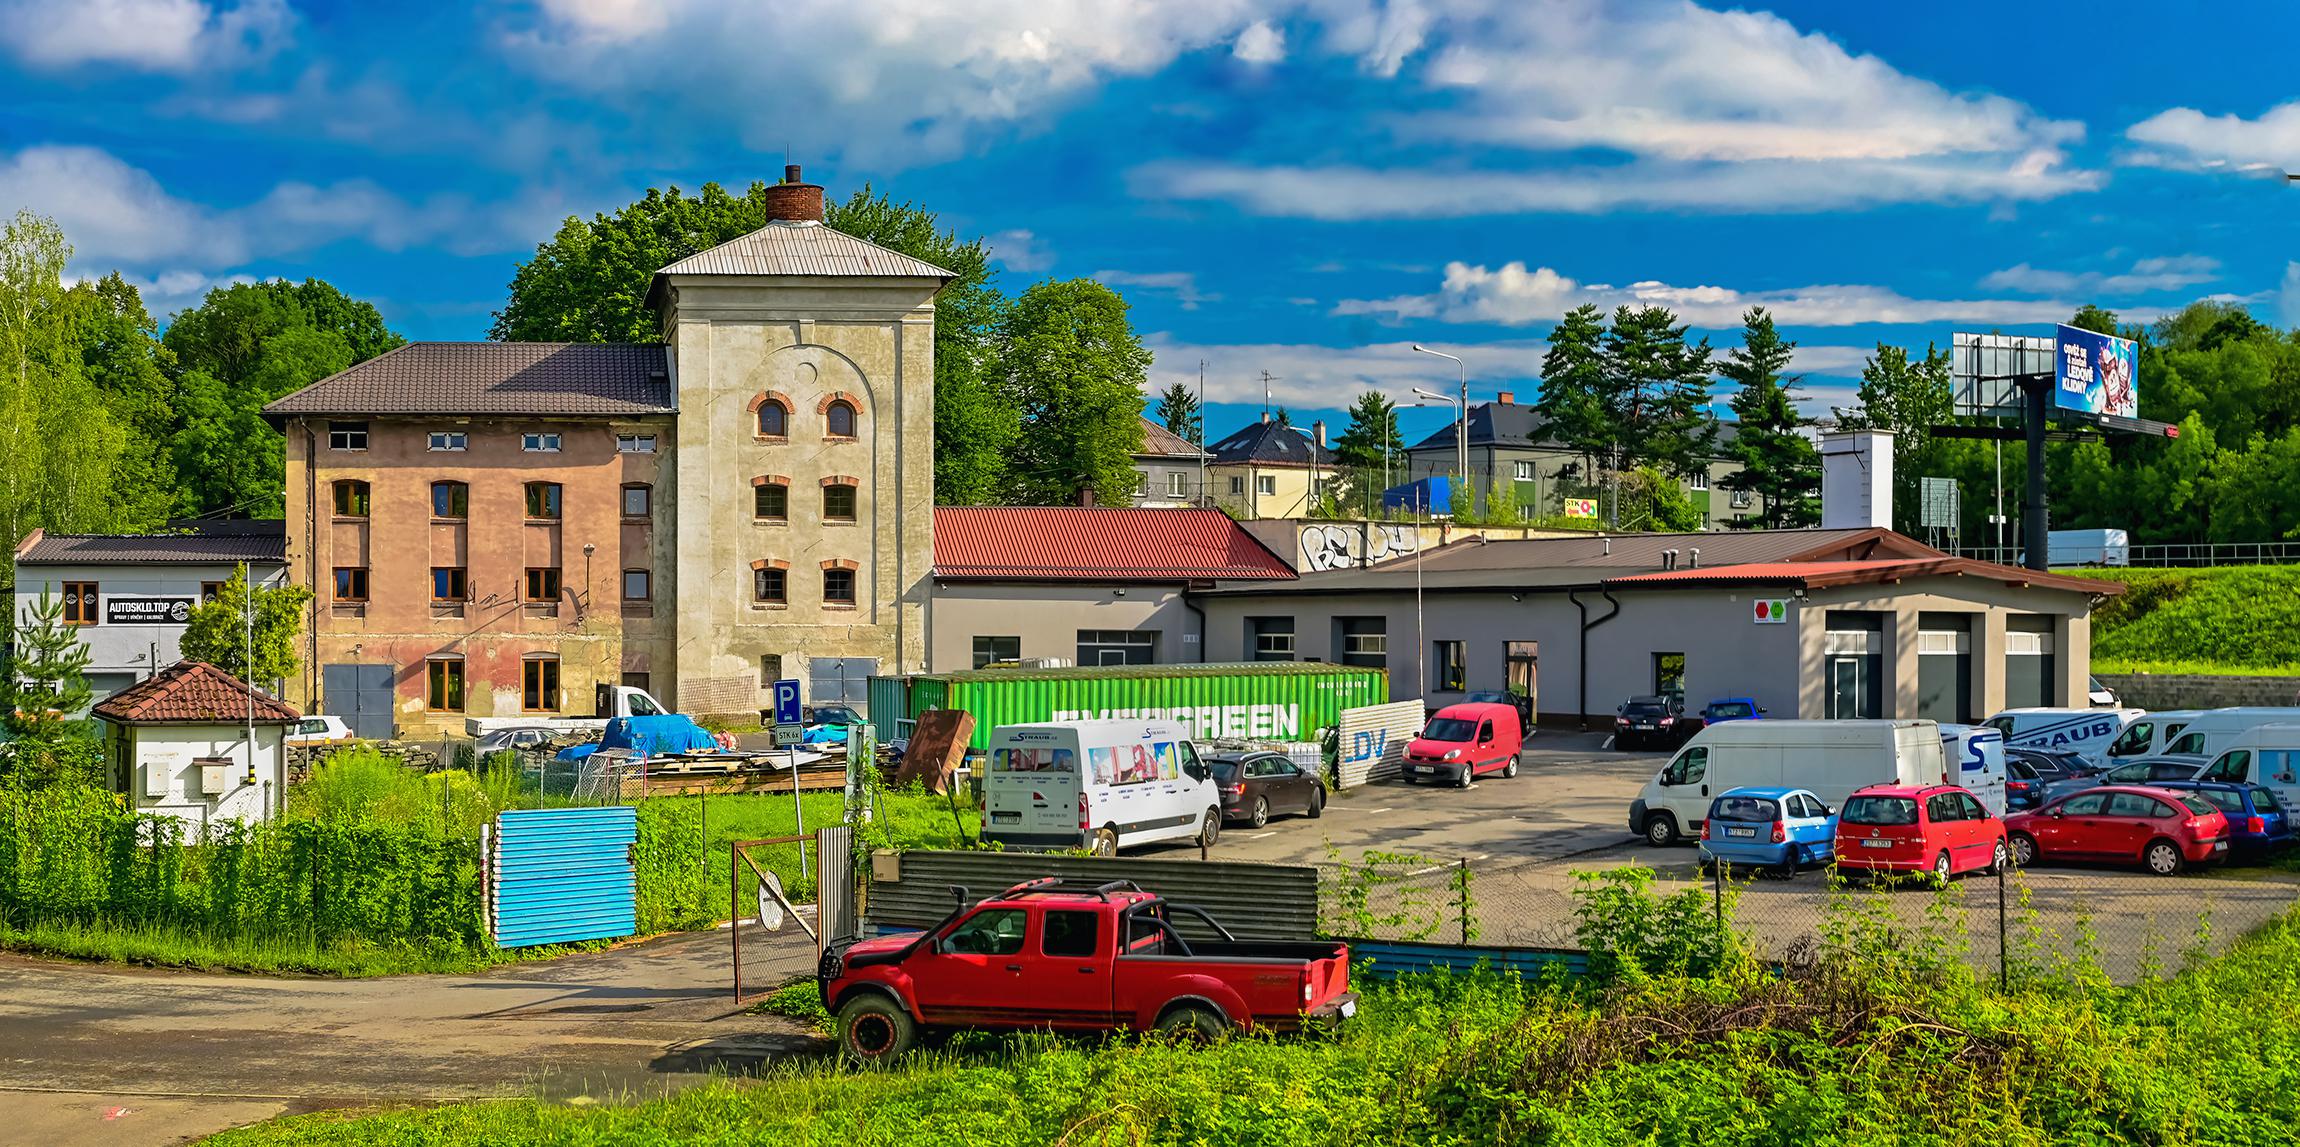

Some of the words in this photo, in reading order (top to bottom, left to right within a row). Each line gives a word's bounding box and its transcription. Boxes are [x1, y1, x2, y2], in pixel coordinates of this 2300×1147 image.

[109, 602, 170, 613] AUTOSKLO.TOP
[779, 686, 795, 711] P
[779, 731, 791, 739] STK
